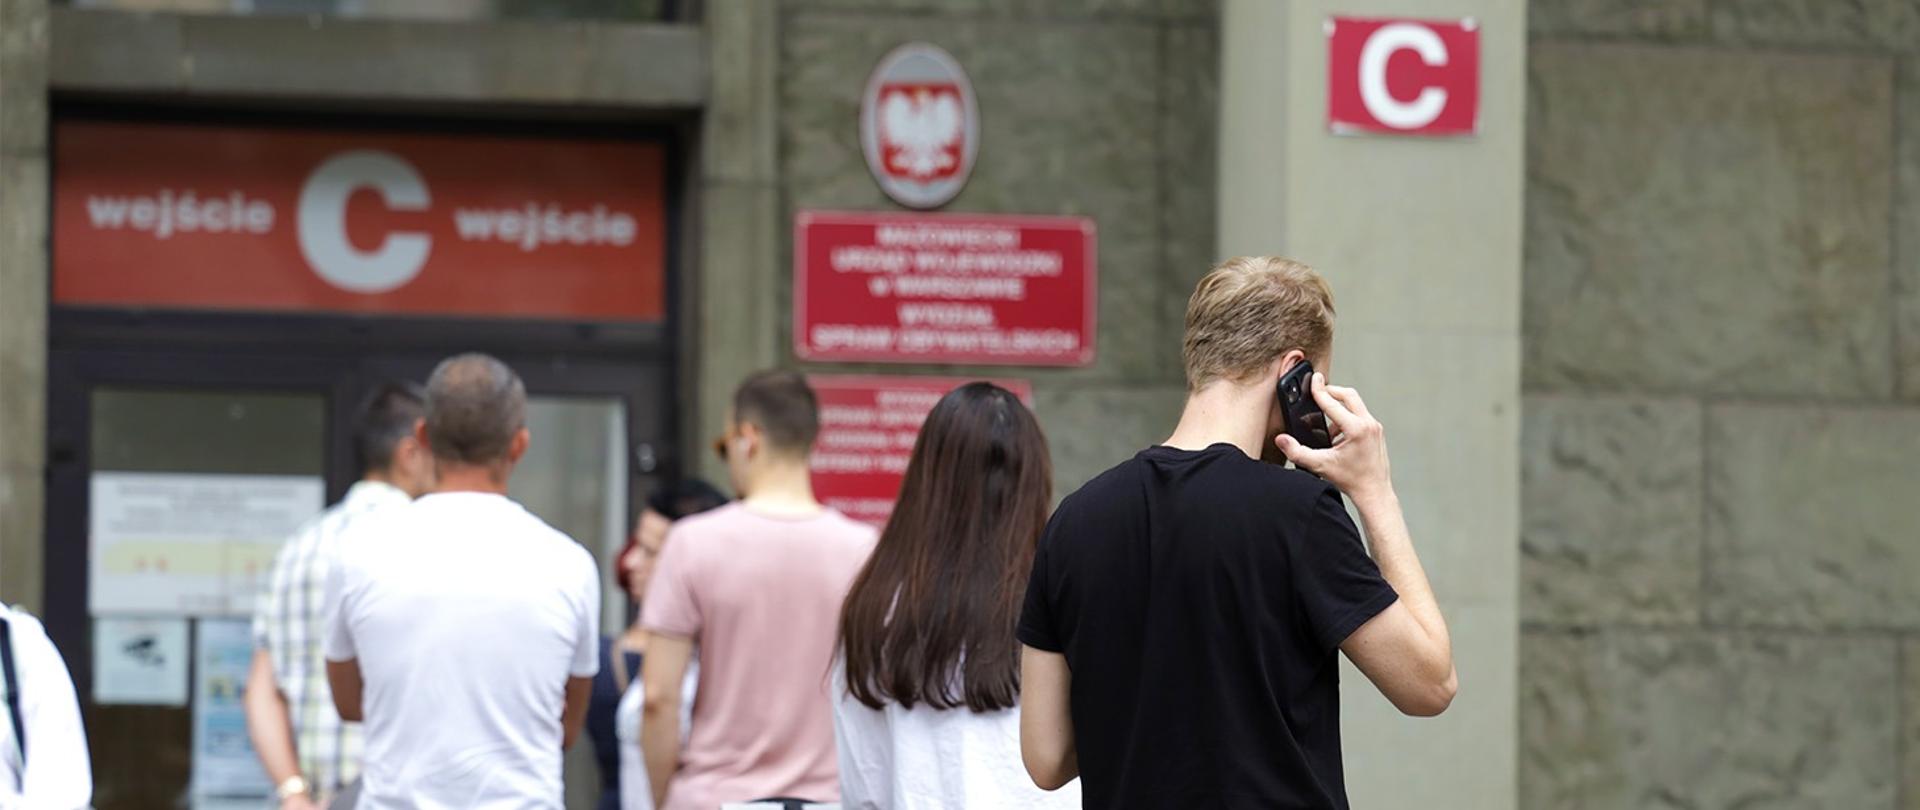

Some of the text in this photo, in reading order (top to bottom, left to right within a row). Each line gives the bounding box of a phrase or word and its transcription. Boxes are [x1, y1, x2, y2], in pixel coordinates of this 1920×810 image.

[1359, 22, 1449, 129] C
[87, 151, 637, 292] wejście C wejście
